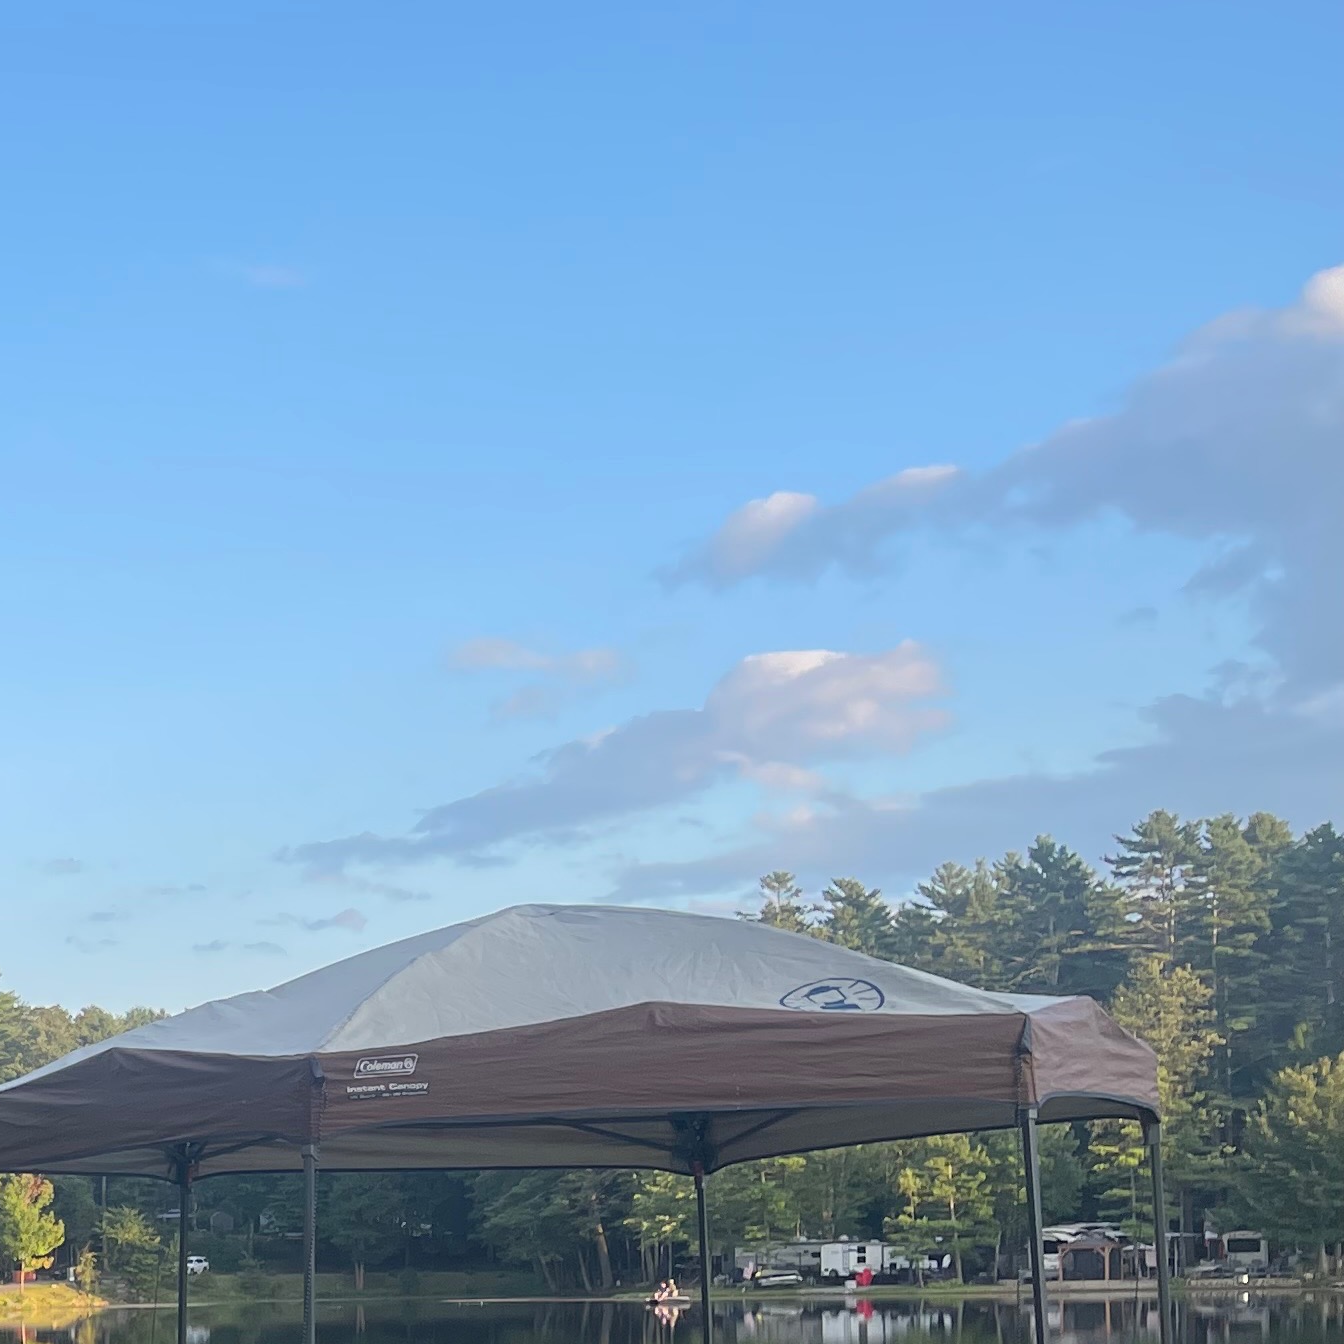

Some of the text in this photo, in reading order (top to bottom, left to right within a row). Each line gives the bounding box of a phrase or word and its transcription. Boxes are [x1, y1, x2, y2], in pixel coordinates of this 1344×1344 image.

[360, 1060, 403, 1072] Coleman
[346, 1082, 429, 1093] Instant Canopy
